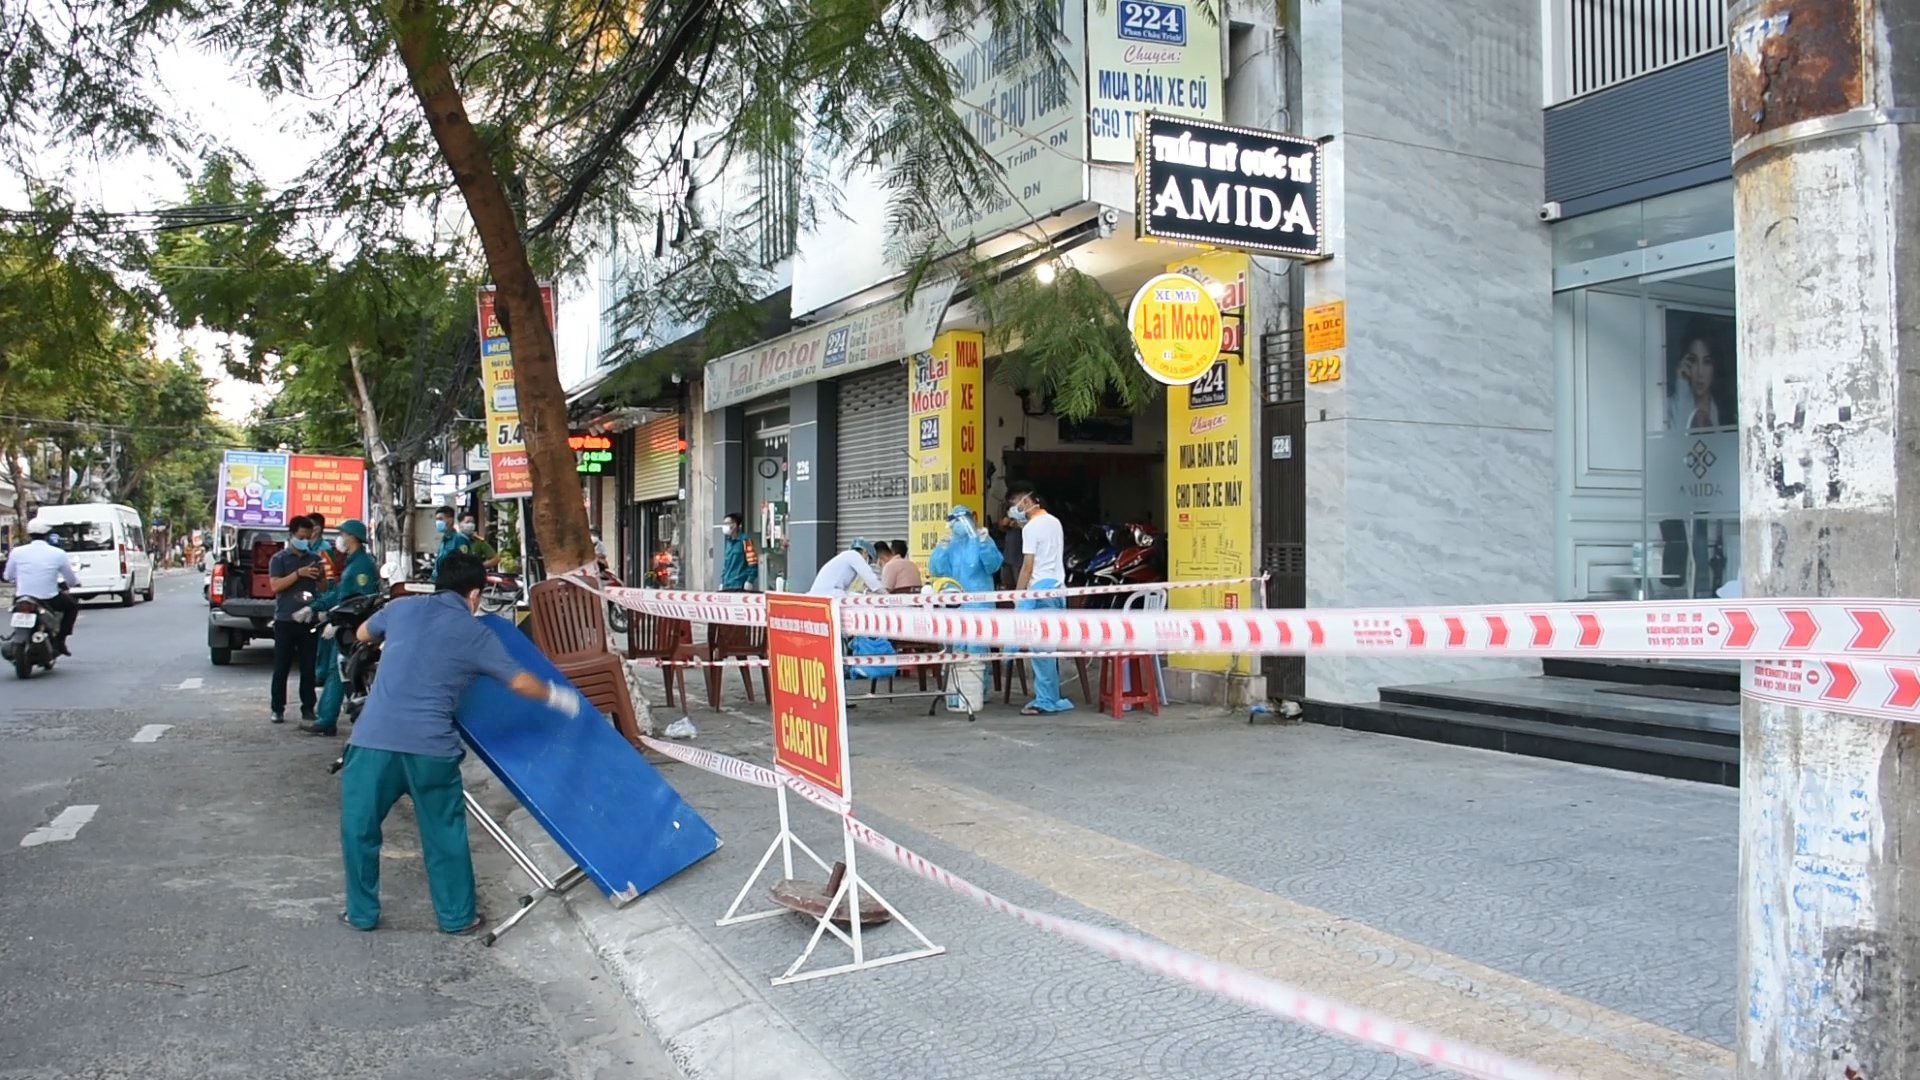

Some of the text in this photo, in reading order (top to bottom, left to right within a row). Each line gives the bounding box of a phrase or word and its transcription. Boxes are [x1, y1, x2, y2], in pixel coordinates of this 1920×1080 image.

[1125, 3, 1180, 32] 224
[1098, 70, 1130, 101] MUA
[1134, 68, 1163, 104] BÁN
[1167, 77, 1185, 107] XE
[1091, 107, 1121, 139] CHO
[1007, 144, 1038, 170] Trinh
[1152, 174, 1317, 236] AMIDA
[1143, 305, 1167, 340] Lai
[1172, 303, 1215, 341] Motor
[728, 354, 755, 389] Lai
[759, 339, 821, 378] Motor
[827, 332, 849, 356] 224
[928, 352, 949, 380] Lai
[956, 340, 978, 367] MUA
[1307, 356, 1341, 384] 222
[911, 388, 949, 414] Motor
[961, 383, 975, 410] XE
[921, 419, 938, 441] 224
[1180, 444, 1196, 469] MUA
[1198, 437, 1213, 468] BÁN
[1215, 441, 1225, 466] XE
[960, 462, 977, 495] GIÁ
[1176, 484, 1191, 508] CHO
[1212, 482, 1222, 507] XE
[776, 653, 827, 709] KHU VỰC
[781, 706, 829, 766] CÁCH LY
